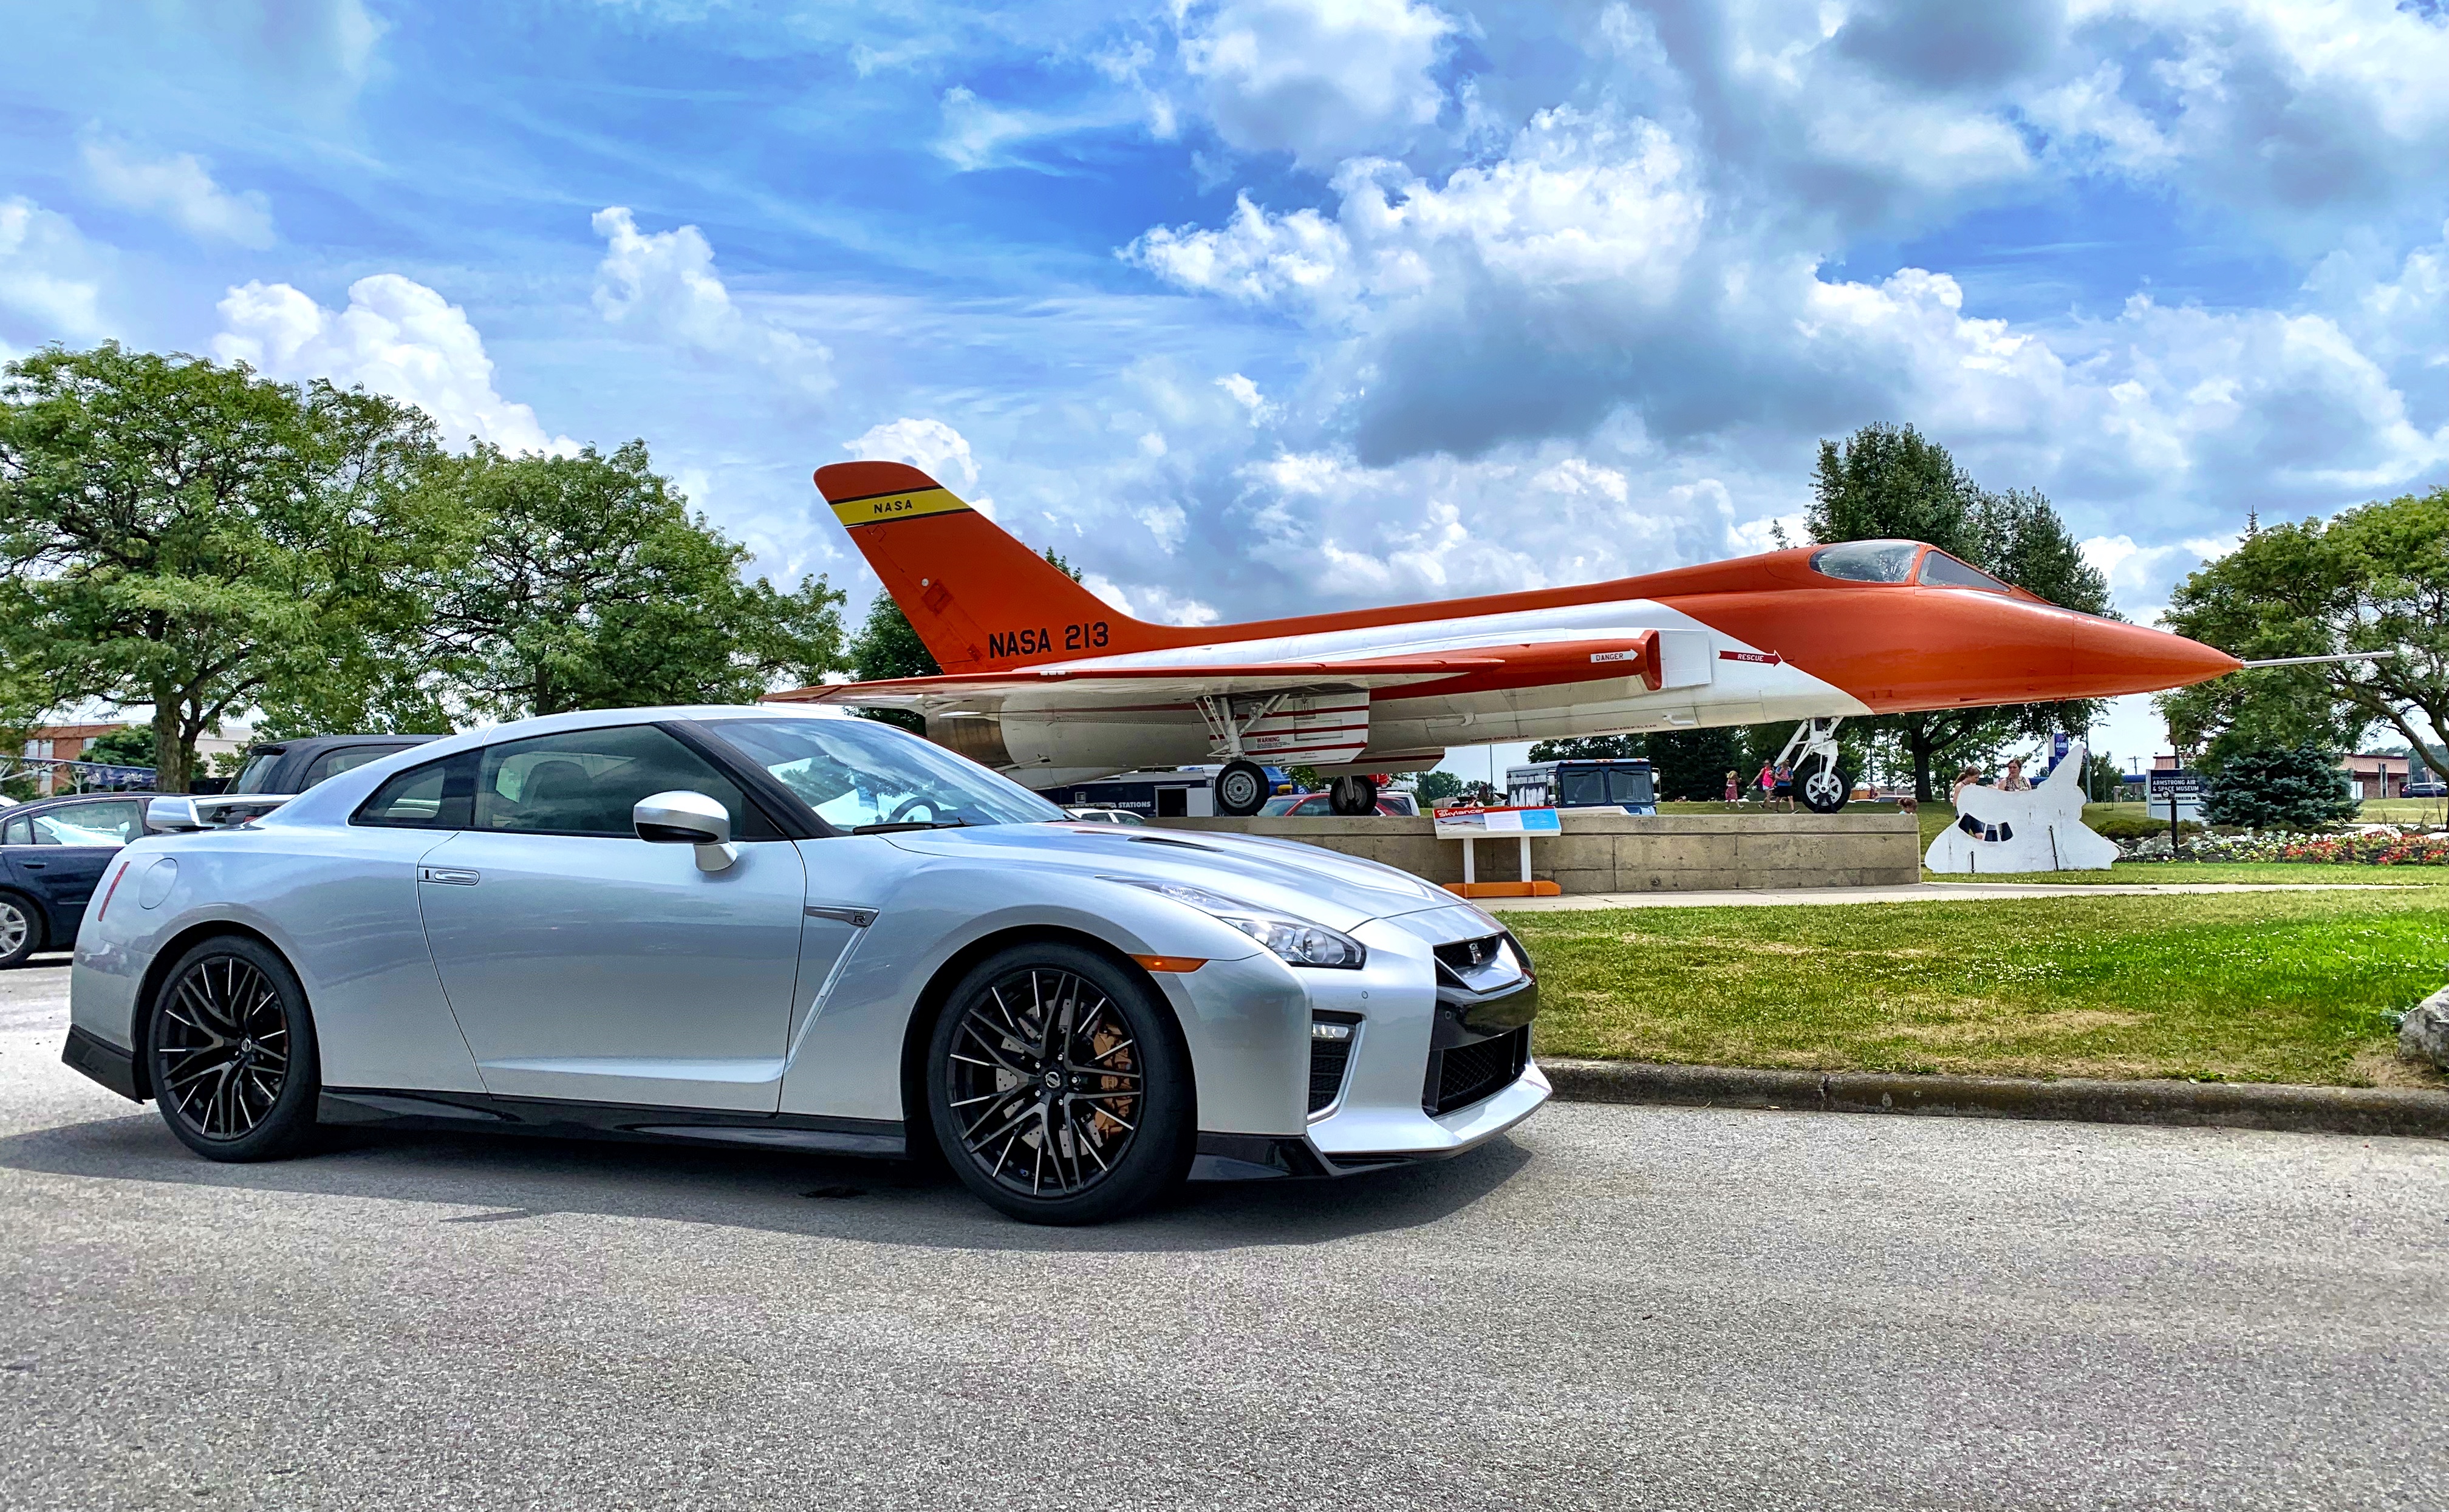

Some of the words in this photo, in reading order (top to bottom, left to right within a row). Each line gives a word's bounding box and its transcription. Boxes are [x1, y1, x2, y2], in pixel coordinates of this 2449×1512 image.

[873, 499, 913, 514] NASA
[989, 627, 1052, 659] NASA
[1065, 621, 1108, 650] 213
[1596, 653, 1624, 661] DANGER
[1737, 653, 1764, 662] RESCUE
[1438, 809, 1485, 817] Skylancer
